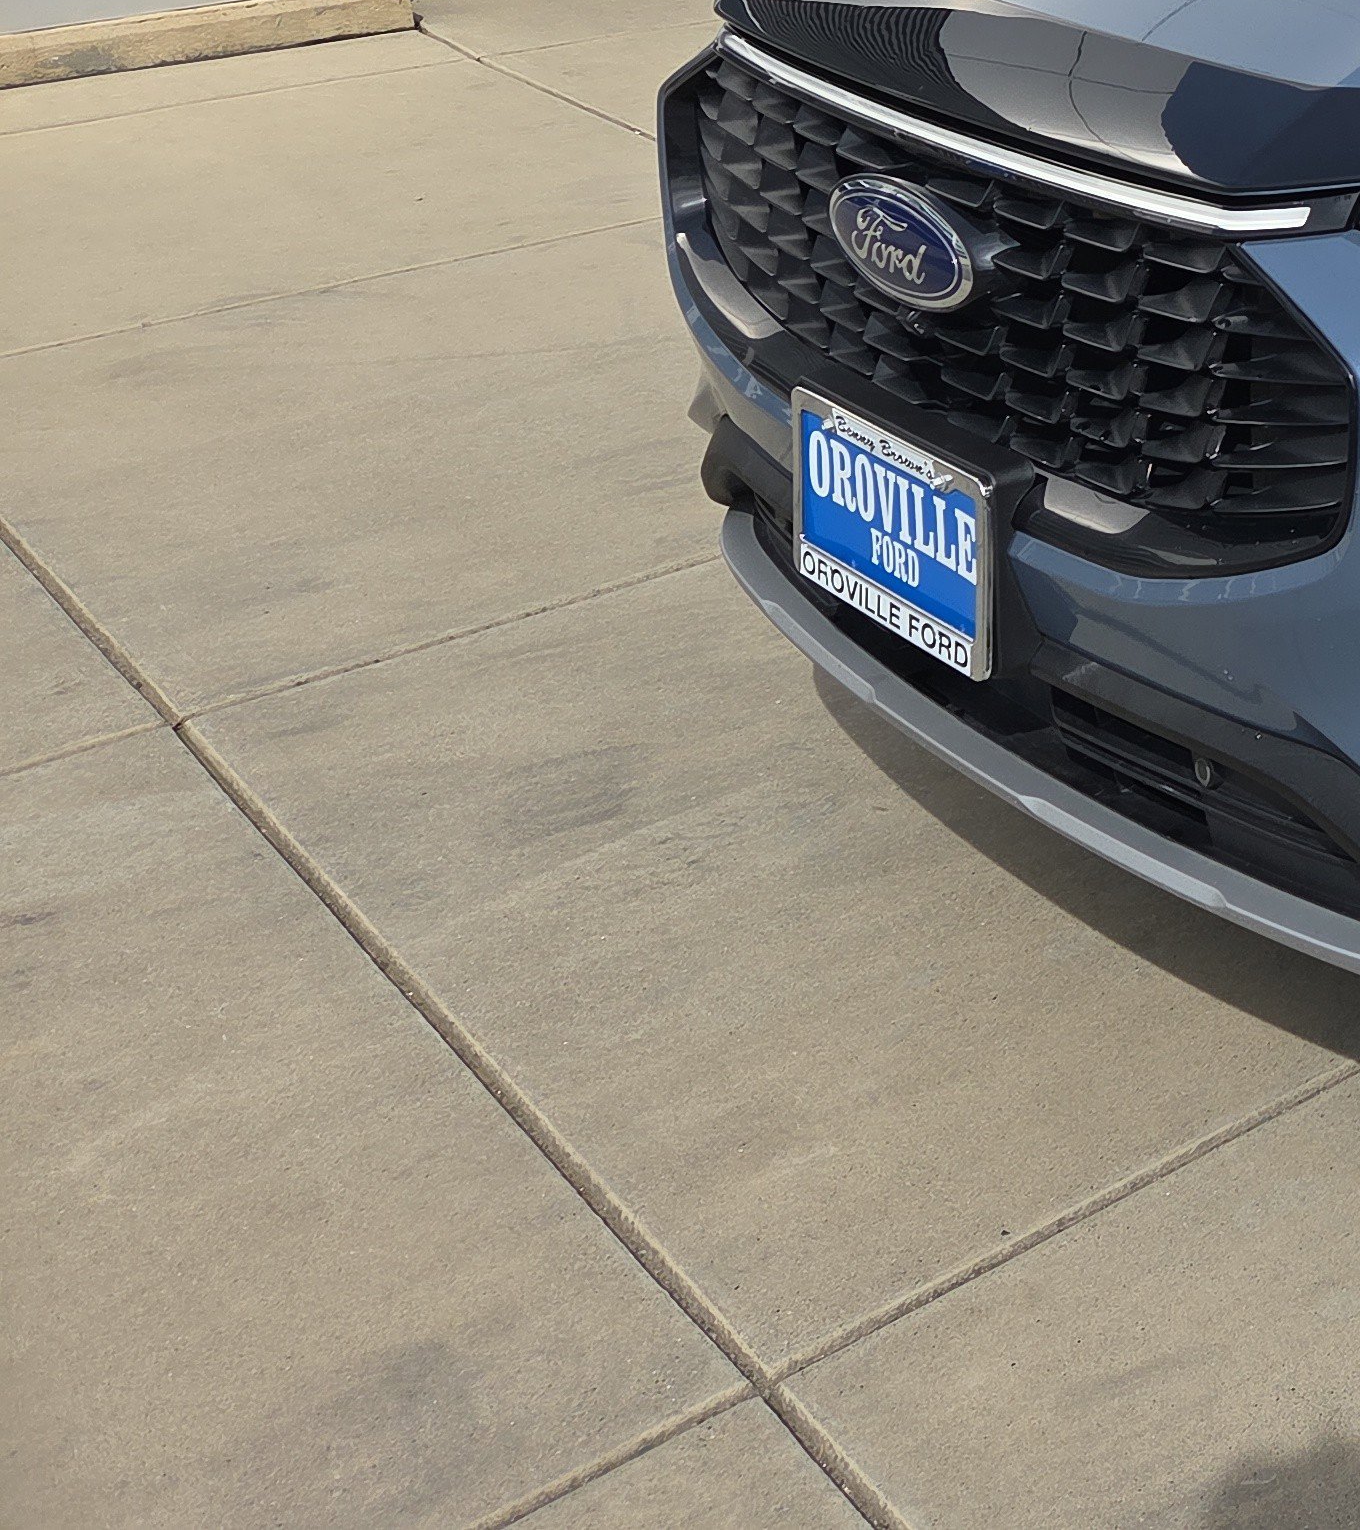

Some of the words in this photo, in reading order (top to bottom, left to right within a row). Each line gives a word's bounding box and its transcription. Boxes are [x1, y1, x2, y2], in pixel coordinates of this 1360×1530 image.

[851, 206, 927, 285] Ford
[809, 430, 978, 585] OROVILLE
[870, 527, 920, 589] FORD
[801, 548, 902, 632] OROVILLE
[908, 613, 970, 672] FORD
